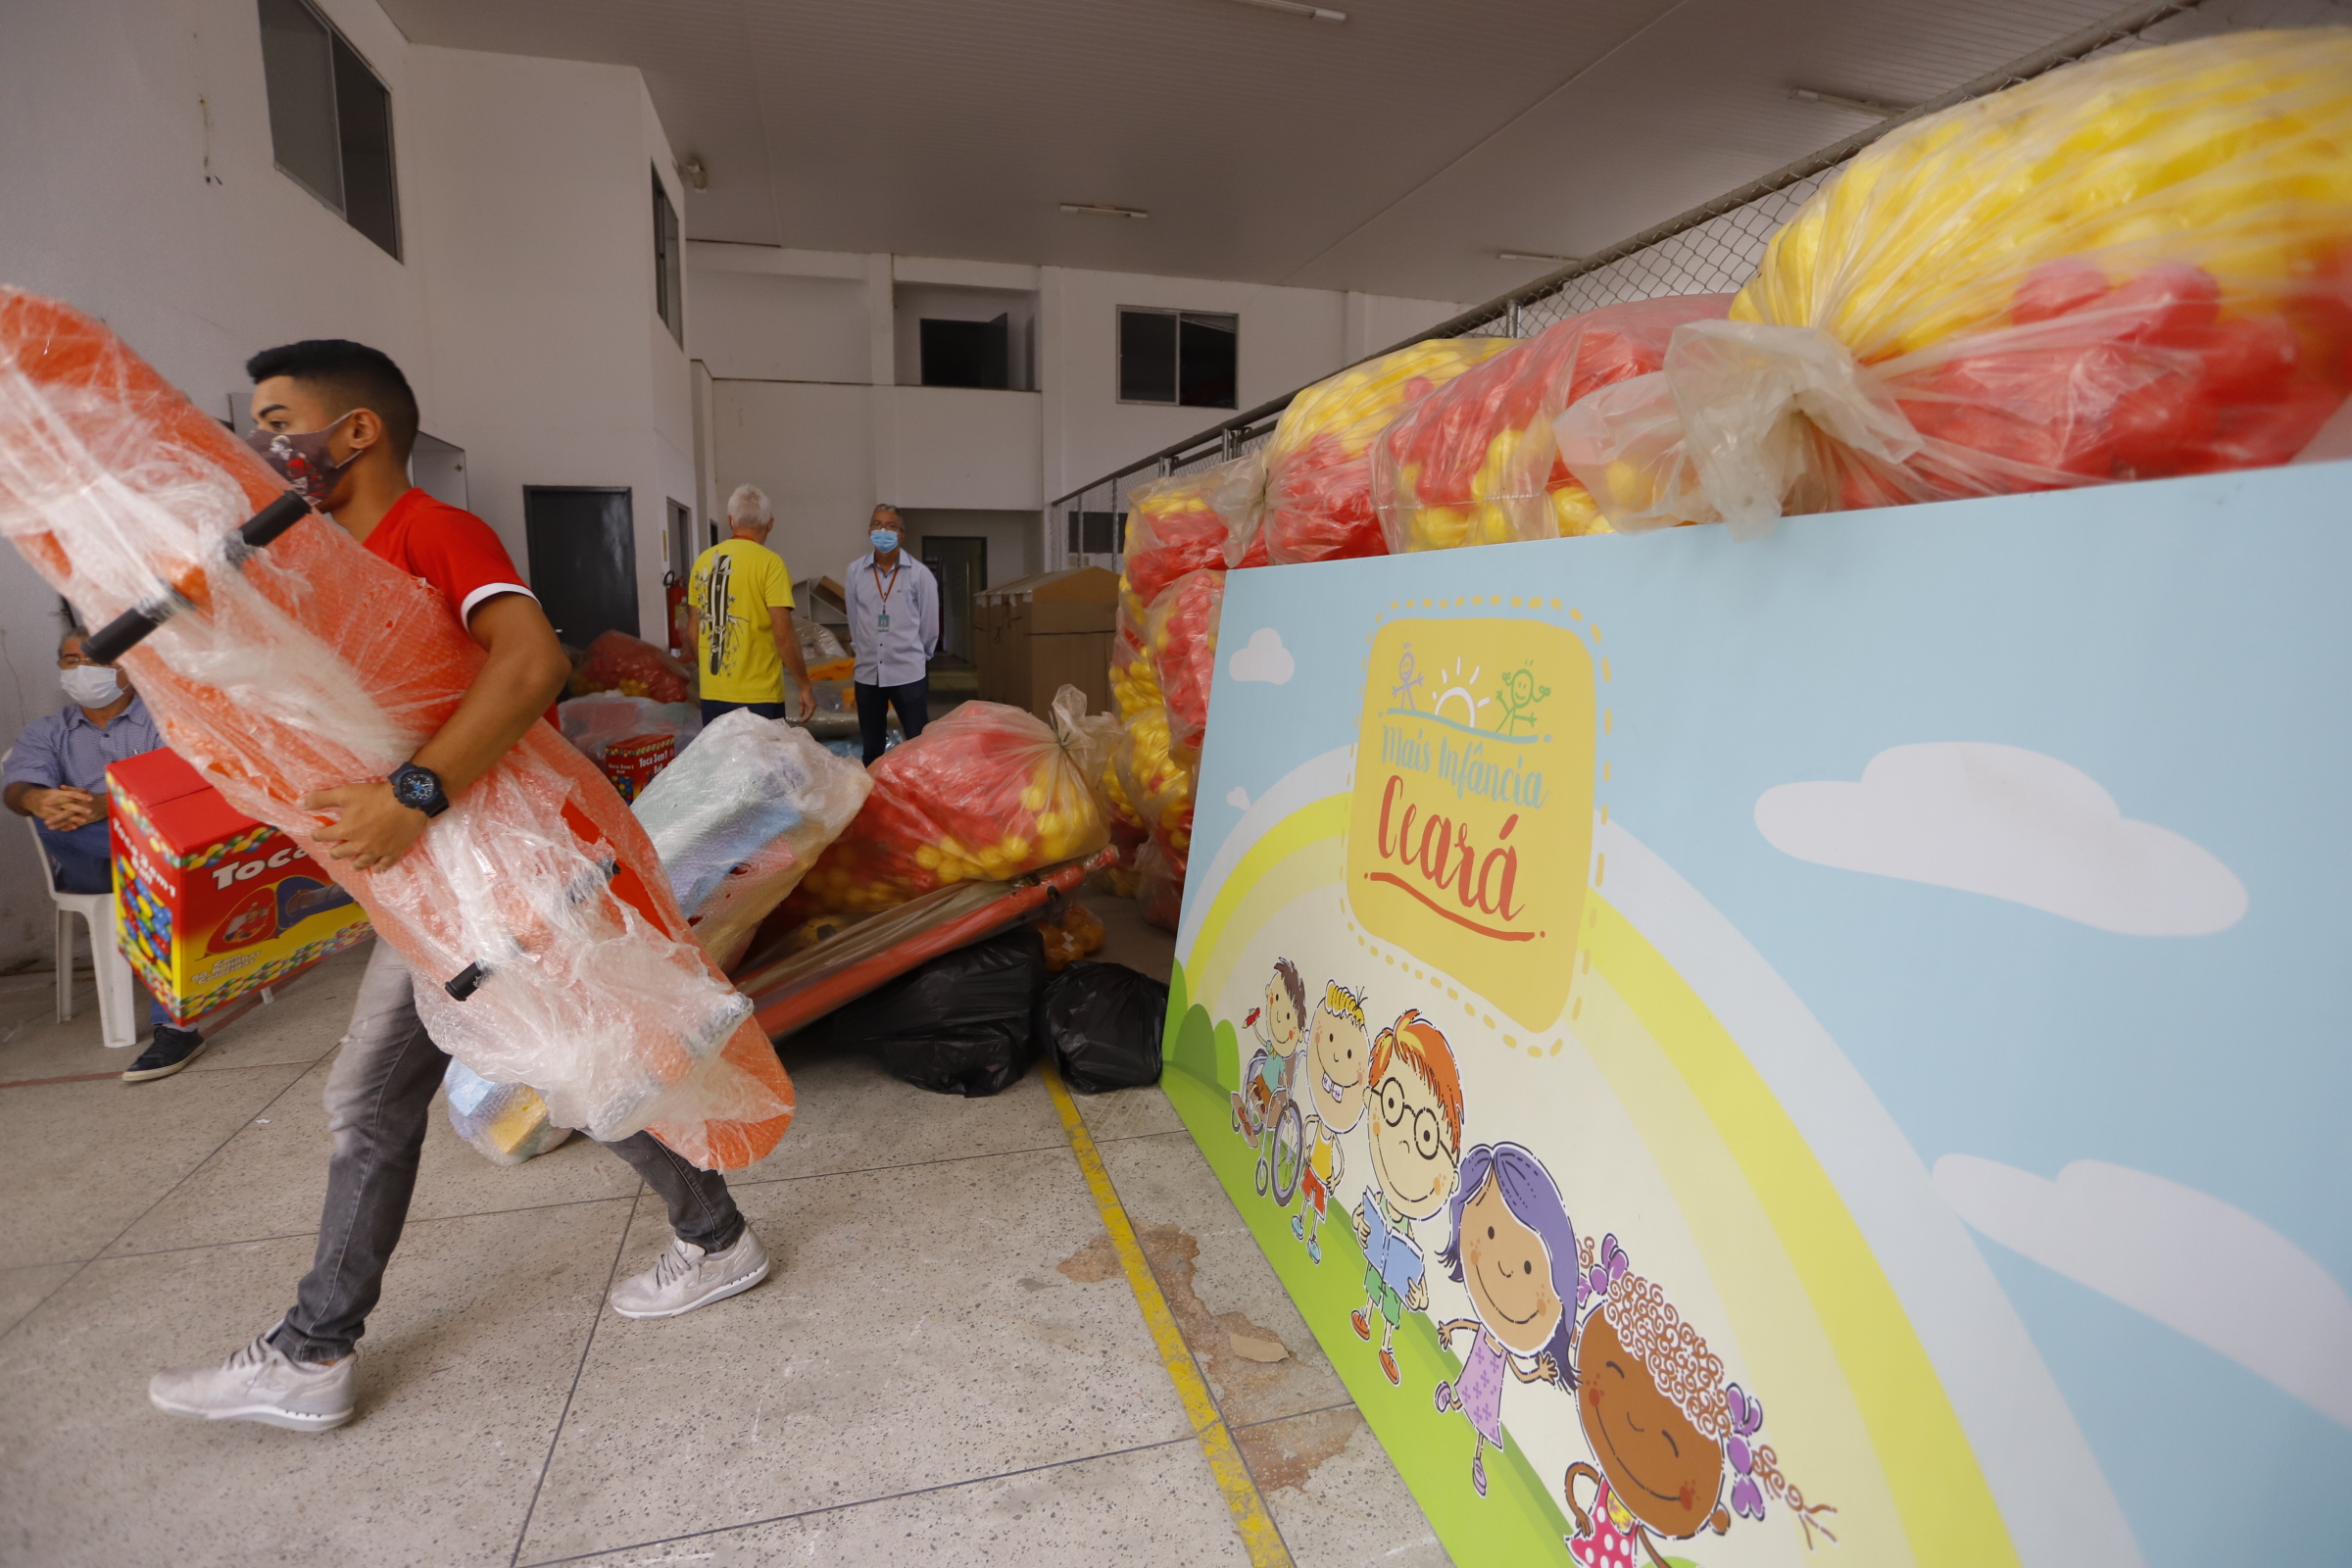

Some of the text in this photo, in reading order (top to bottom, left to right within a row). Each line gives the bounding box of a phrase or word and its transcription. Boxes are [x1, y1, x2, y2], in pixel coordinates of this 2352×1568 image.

[1381, 725, 1550, 808] Mais Infância
[1378, 775, 1526, 922] Ceará
